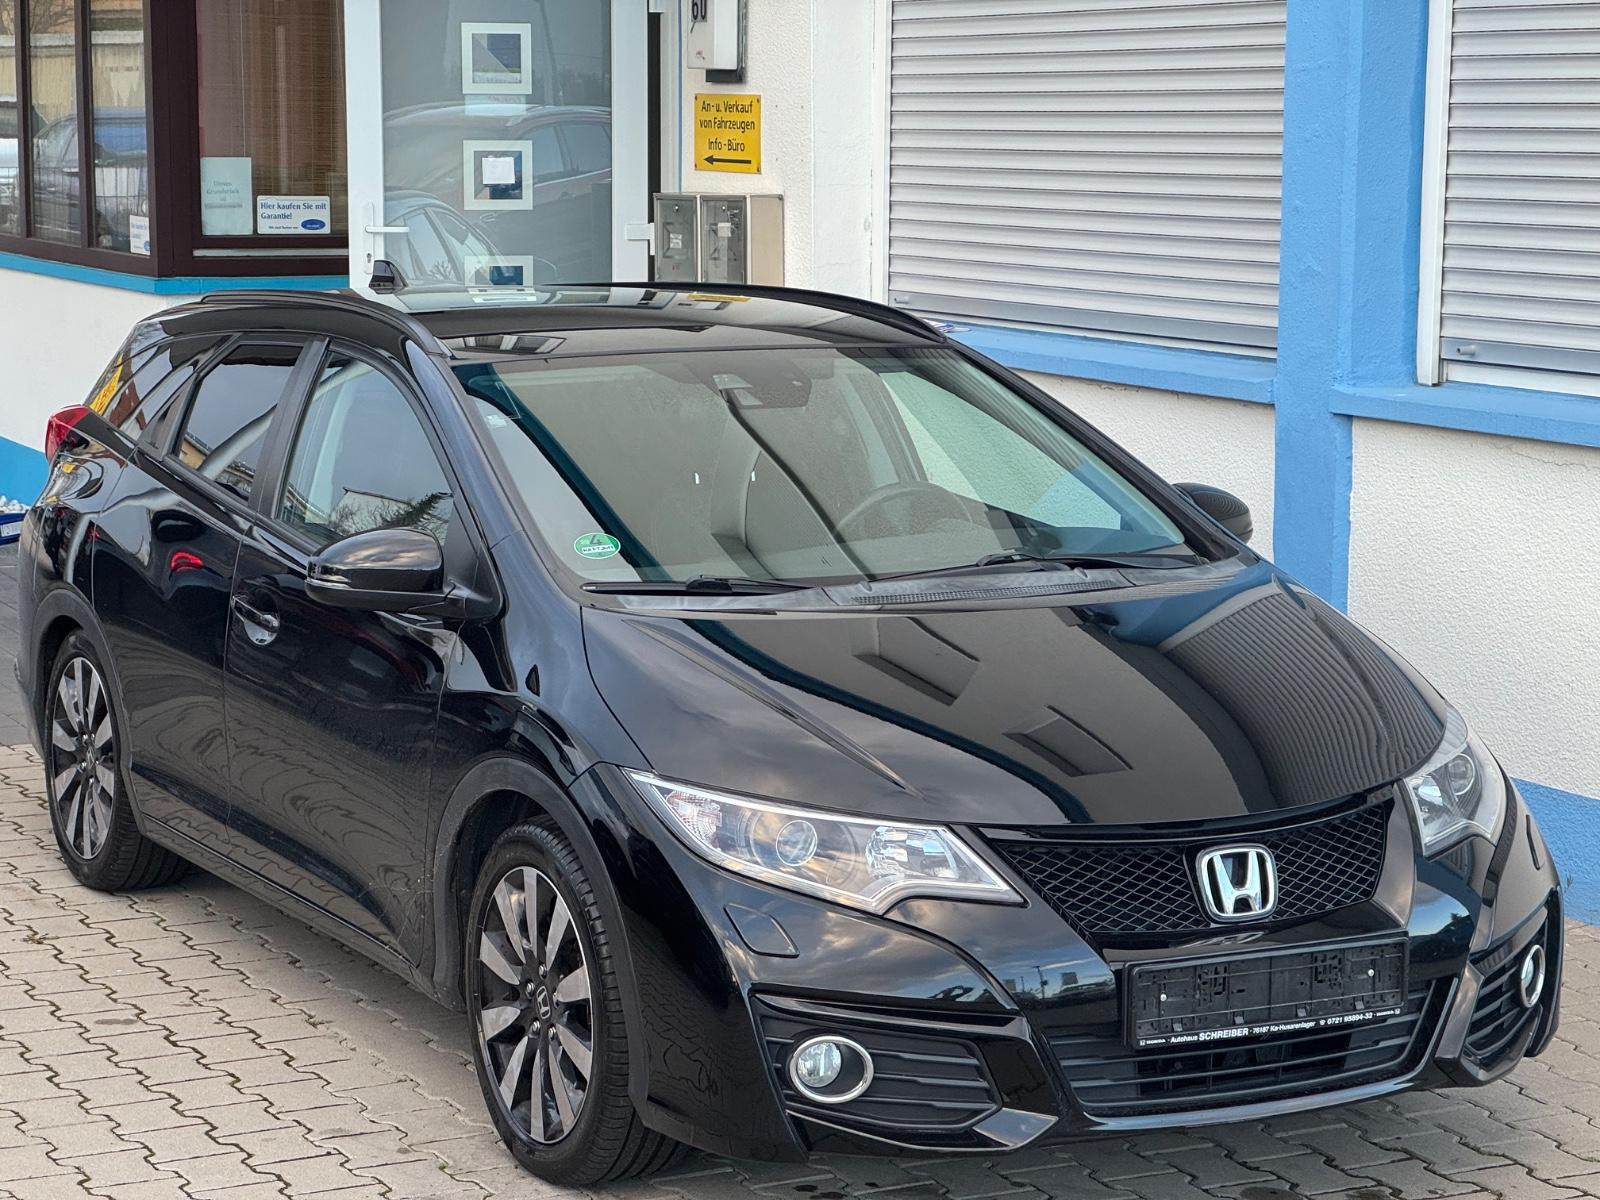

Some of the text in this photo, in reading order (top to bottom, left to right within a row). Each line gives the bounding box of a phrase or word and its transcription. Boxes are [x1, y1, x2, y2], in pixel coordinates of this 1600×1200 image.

[723, 100, 753, 114] Verkauf
[699, 116, 755, 134] von Fahrzeugen
[260, 202, 327, 210] Hier kaufen Sie mit
[260, 212, 293, 220] Garantie!
[1170, 1035, 1198, 1043] Autohaus
[1198, 1027, 1249, 1041] SCHREIBER
[1327, 1016, 1343, 1025] 0721
